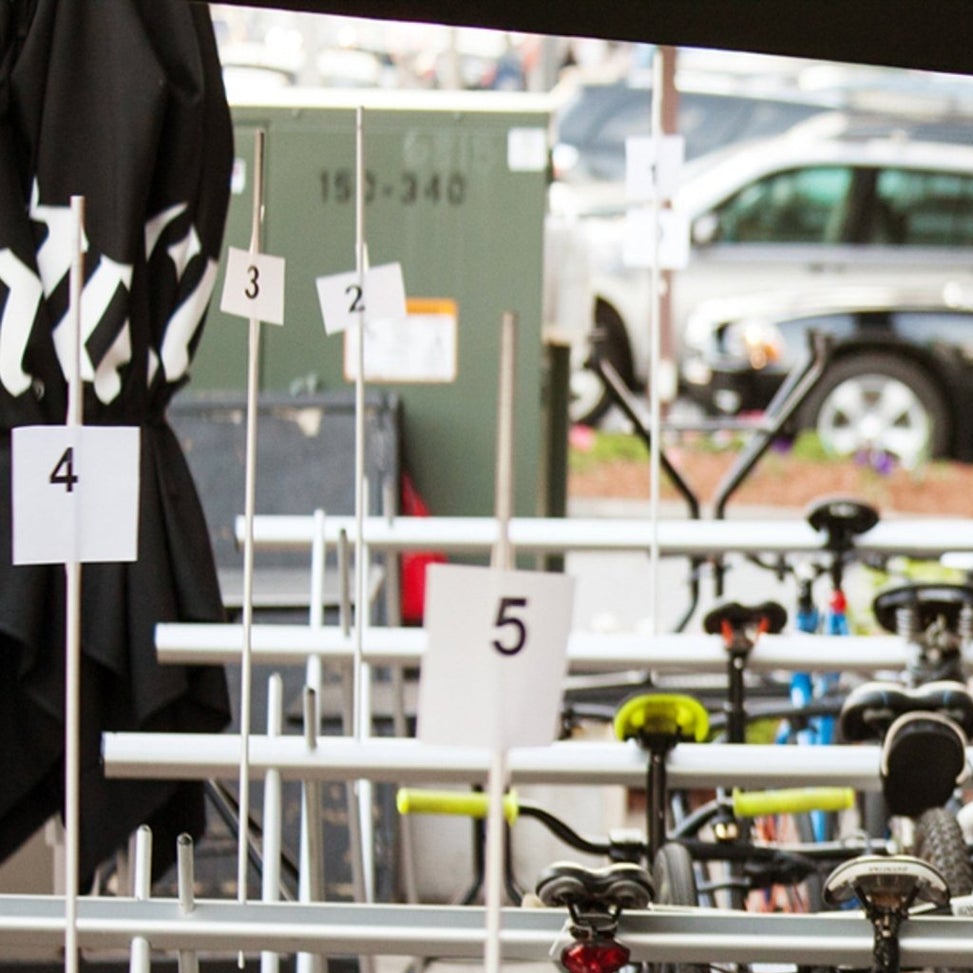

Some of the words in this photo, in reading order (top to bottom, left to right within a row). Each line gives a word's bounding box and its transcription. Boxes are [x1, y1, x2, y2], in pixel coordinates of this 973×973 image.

[244, 265, 260, 300] 3
[344, 285, 366, 314] 2
[49, 446, 79, 493] 4
[493, 597, 527, 656] 5
